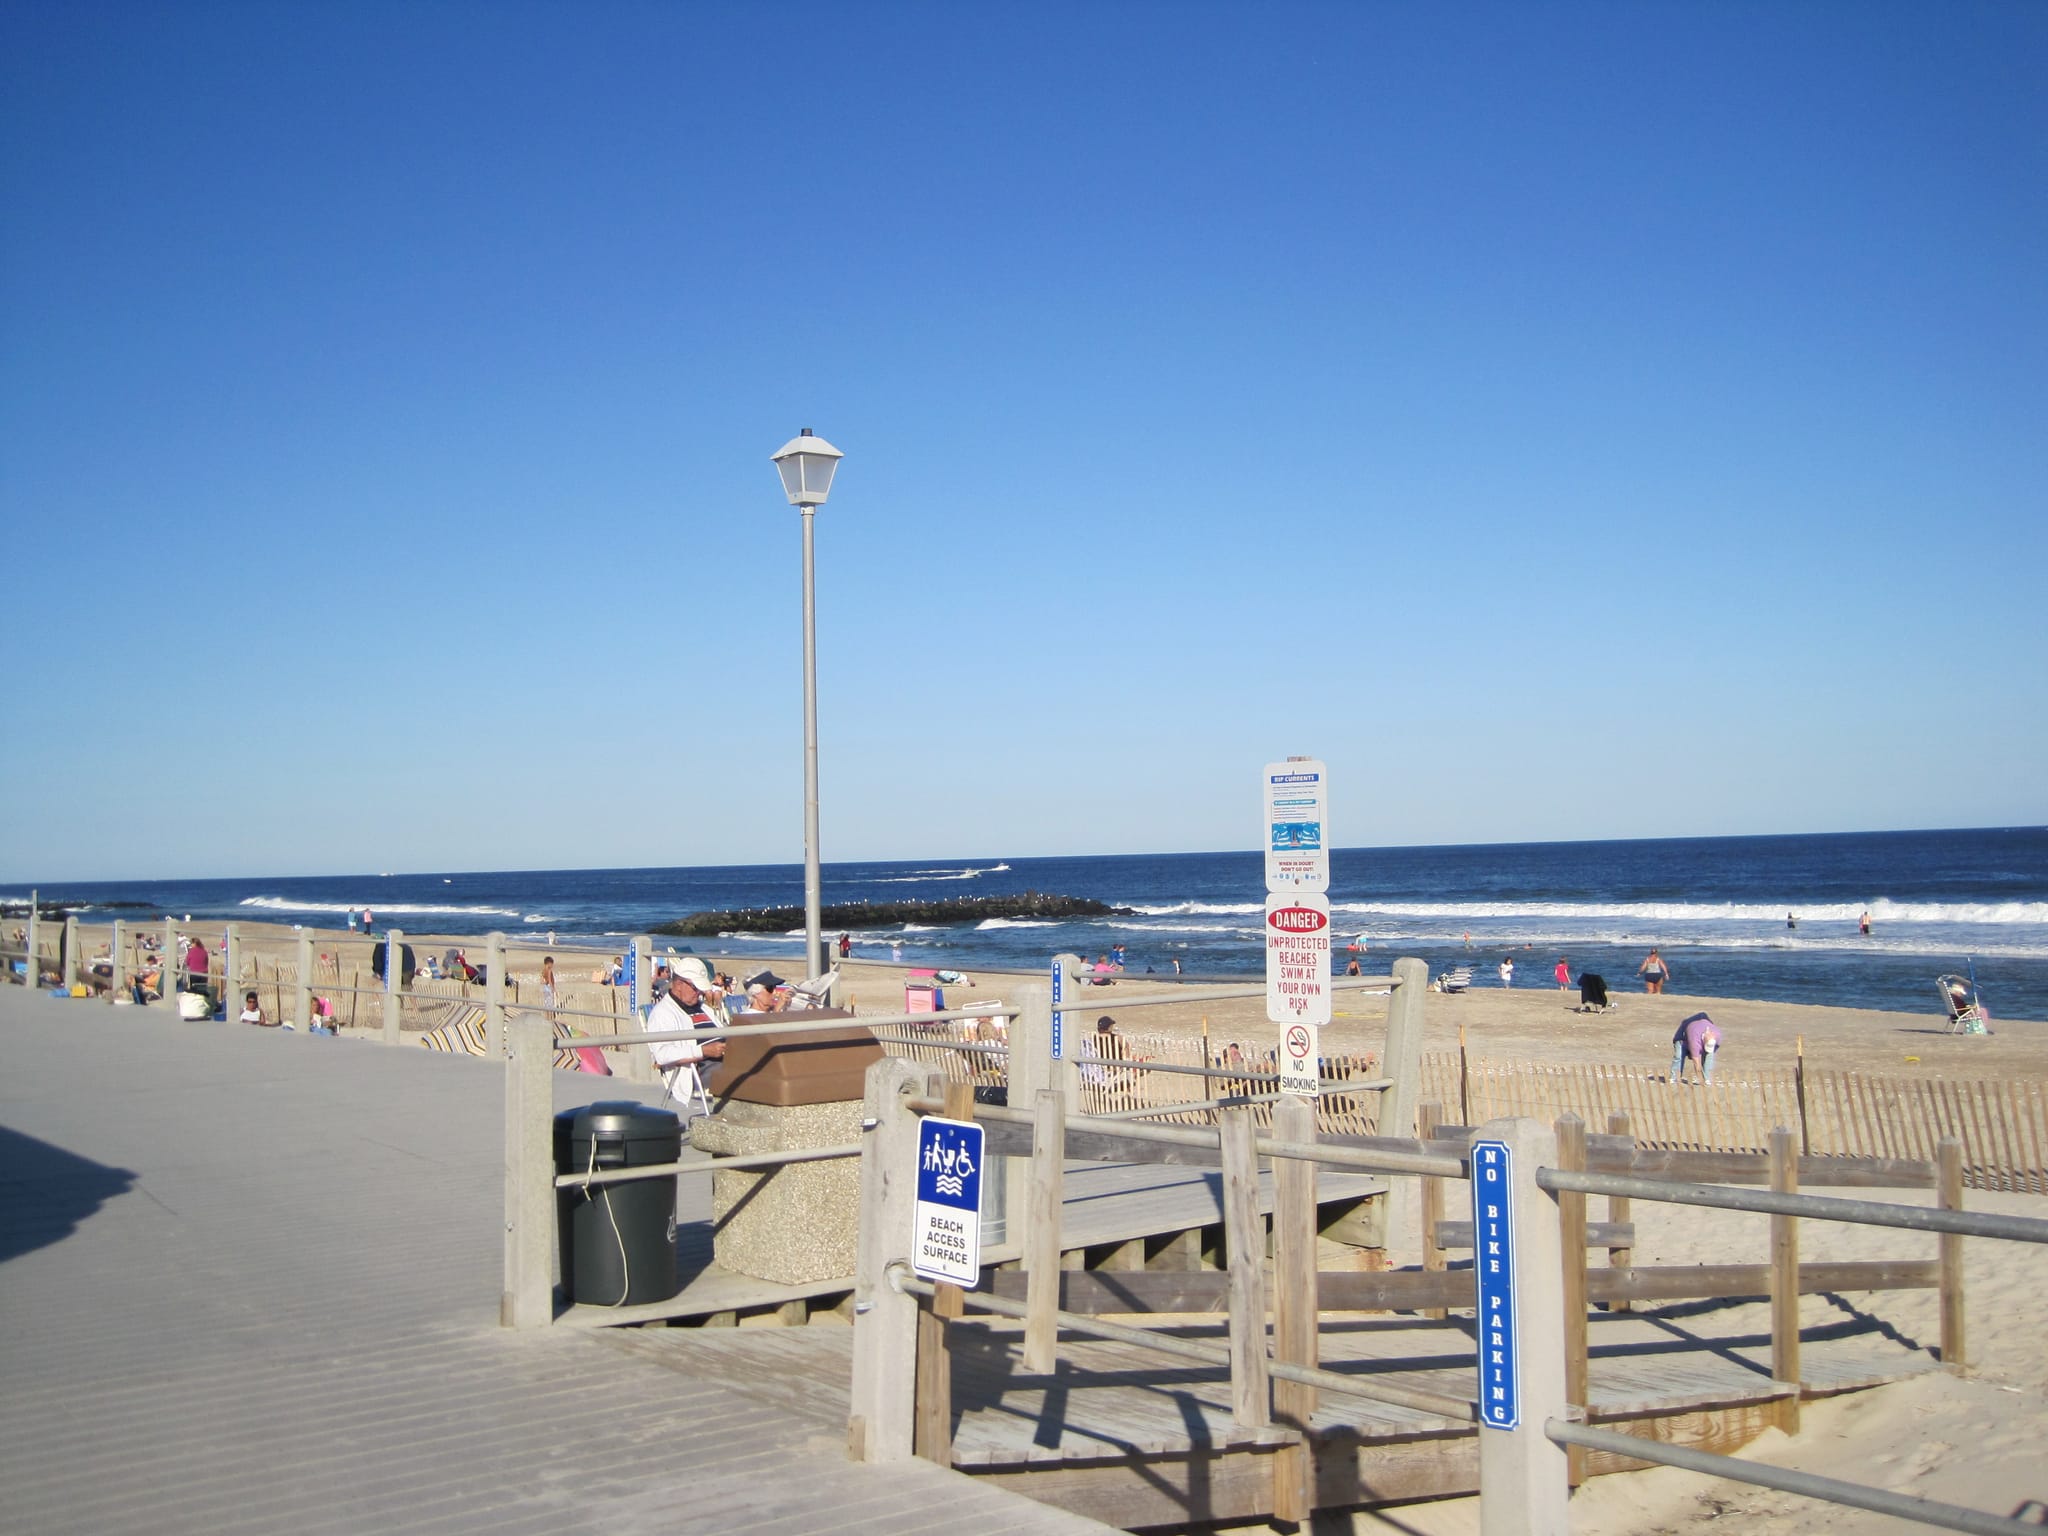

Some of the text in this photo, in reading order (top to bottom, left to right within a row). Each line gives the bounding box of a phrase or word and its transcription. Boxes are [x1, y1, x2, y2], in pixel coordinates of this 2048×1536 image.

[1276, 912, 1319, 929] DANGER
[1268, 936, 1328, 950] UNPROTECTED
[1279, 952, 1317, 965] BEACHES
[1281, 967, 1316, 980] SWIM AT
[1277, 982, 1321, 995] YOUR OWN
[1289, 997, 1309, 1010] RISK
[1293, 1059, 1304, 1072] NO
[1282, 1076, 1317, 1091] SMOKING
[930, 1217, 964, 1233] BEACH
[927, 1231, 965, 1249] ACCESS
[923, 1245, 968, 1265] SURFACE
[1485, 1150, 1505, 1419] NO BIKE PARKING
